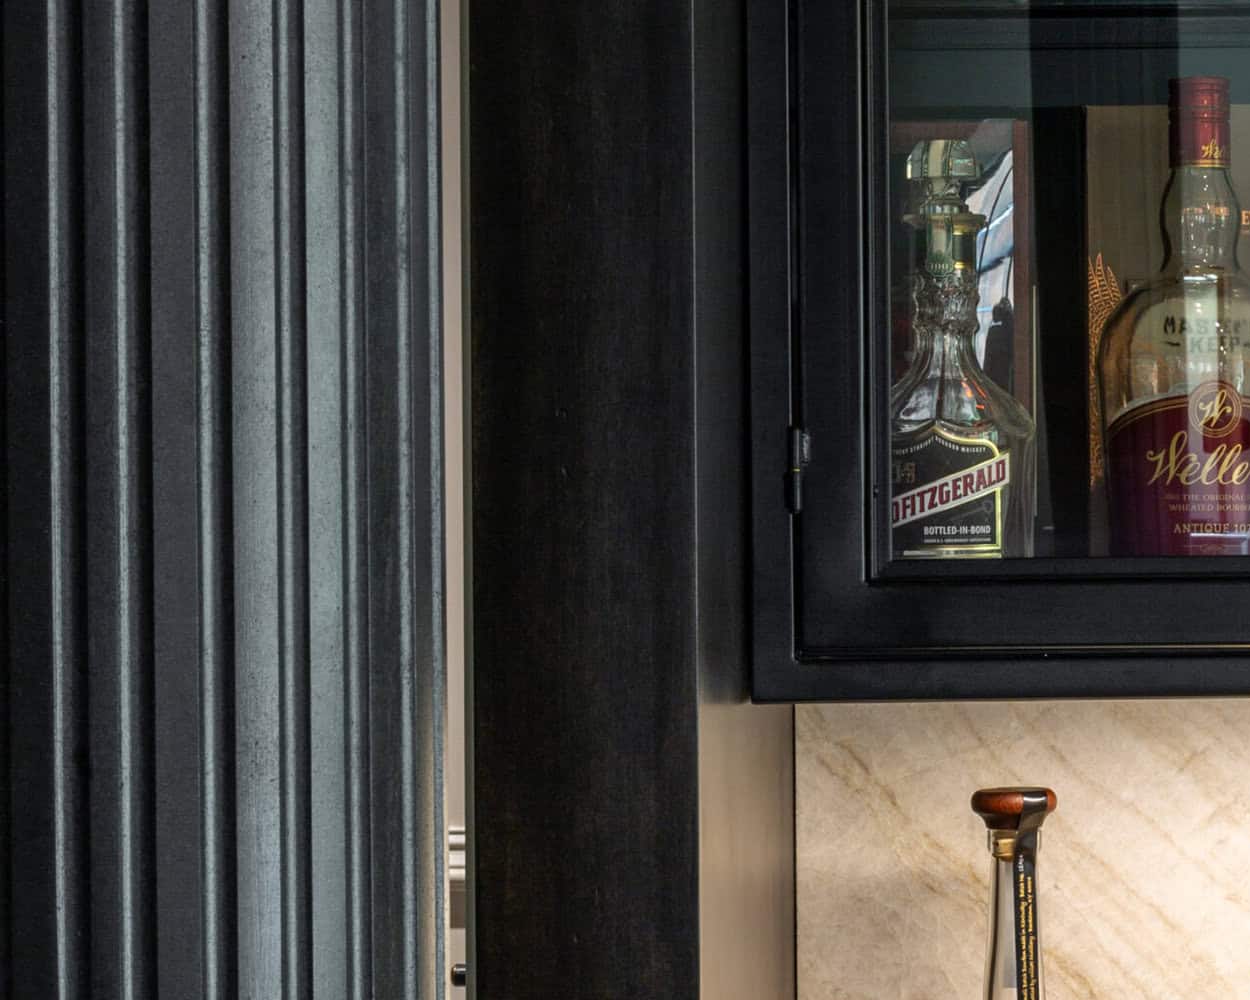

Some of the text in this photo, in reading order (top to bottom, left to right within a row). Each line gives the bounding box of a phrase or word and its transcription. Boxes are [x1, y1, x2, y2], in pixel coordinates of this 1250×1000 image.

[902, 458, 1006, 521] FITZGERALD
[923, 524, 991, 536] BOTTLED-IN-BOND
[1173, 523, 1230, 534] ANTIQUE
